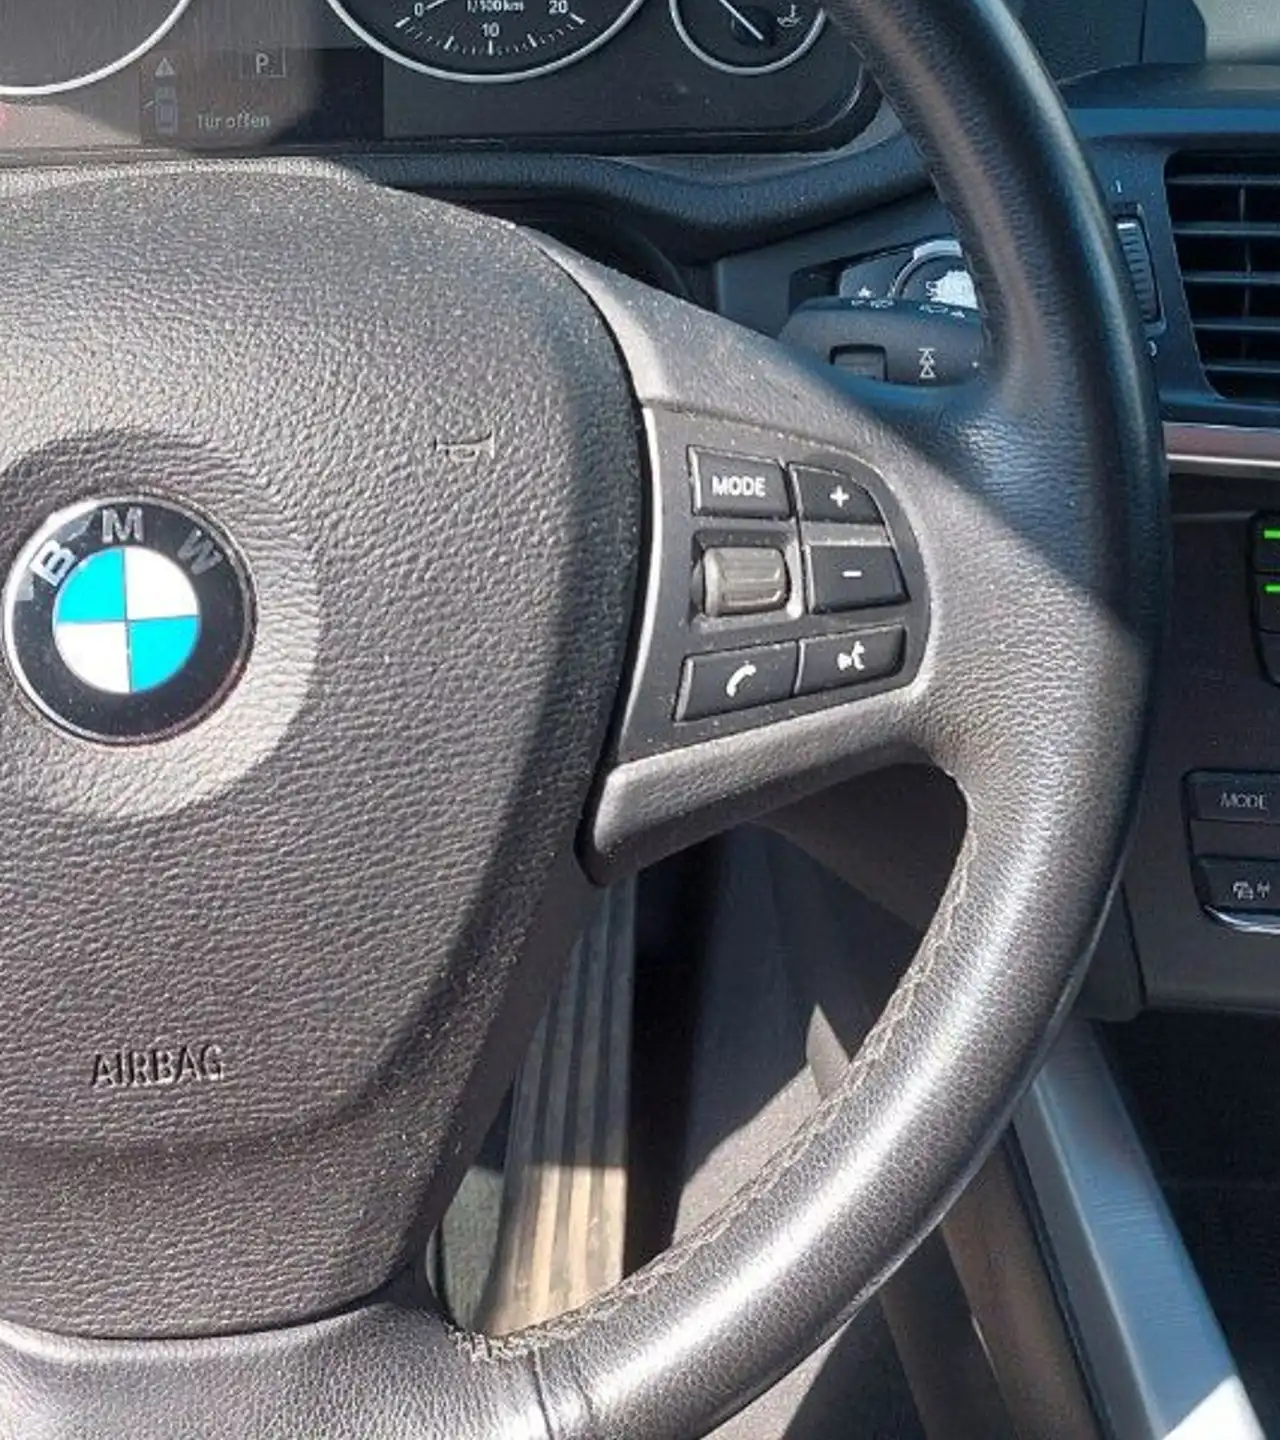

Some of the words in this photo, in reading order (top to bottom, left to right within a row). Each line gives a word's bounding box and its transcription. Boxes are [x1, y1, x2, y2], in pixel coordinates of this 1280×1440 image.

[413, 2, 425, 17] 0
[482, 22, 500, 38] 10
[255, 53, 269, 74] P
[225, 113, 271, 131] offen
[711, 475, 767, 498] MODE
[30, 506, 225, 587] BMW
[1220, 793, 1269, 810] MODE
[90, 1044, 227, 1089] AIRBAG
